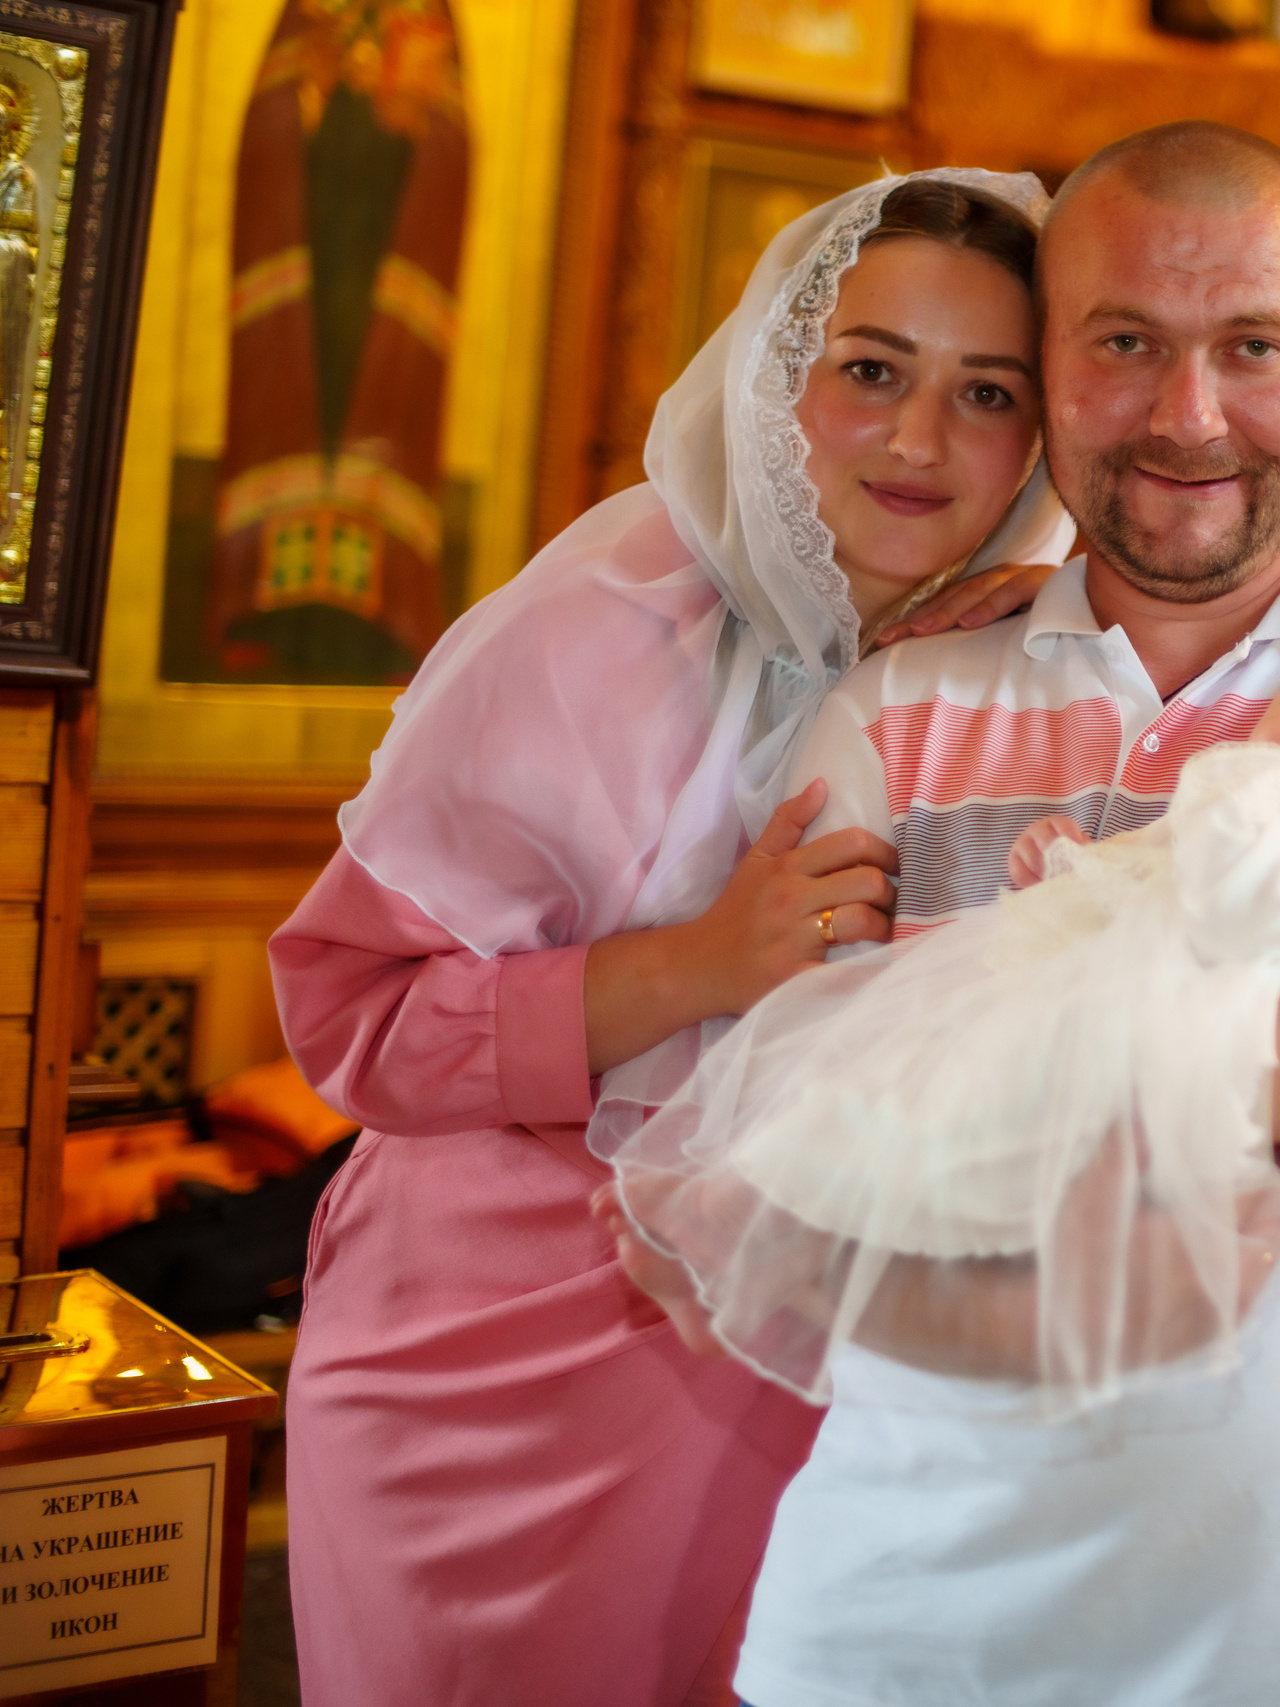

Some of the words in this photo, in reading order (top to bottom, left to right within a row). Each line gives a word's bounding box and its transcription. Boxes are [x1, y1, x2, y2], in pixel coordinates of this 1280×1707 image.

[42, 1488, 139, 1516] ЖЕРТВА
[32, 1522, 183, 1559] УКРАШЕНИЕ
[2, 1587, 18, 1605] И
[25, 1564, 169, 1601] ЗОЛОЧЕНИЕ
[50, 1612, 119, 1639] ИКОН
